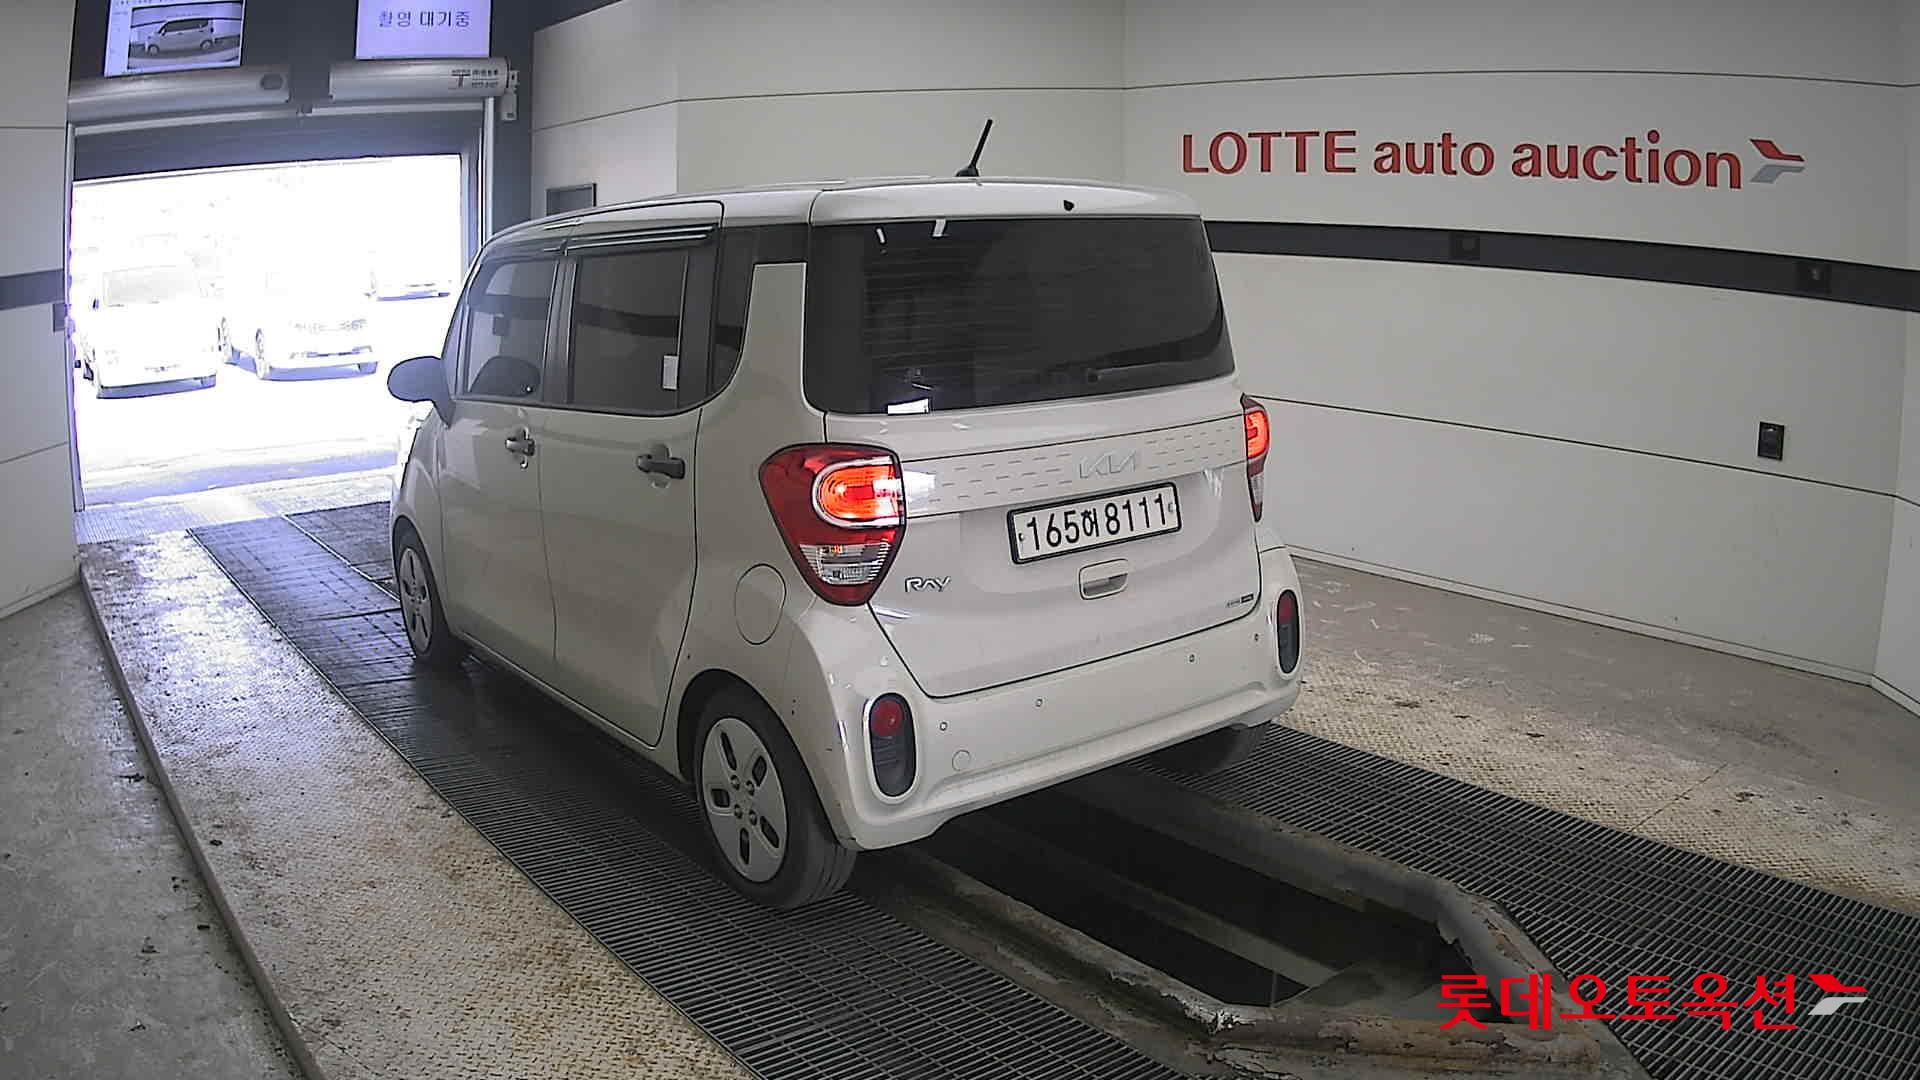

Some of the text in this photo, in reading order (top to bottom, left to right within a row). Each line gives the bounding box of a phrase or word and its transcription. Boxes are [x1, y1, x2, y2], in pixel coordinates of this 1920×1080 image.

[419, 10, 471, 28] 대기중
[1182, 129, 1743, 190] LOTTE auto auction
[904, 574, 951, 593] RAY
